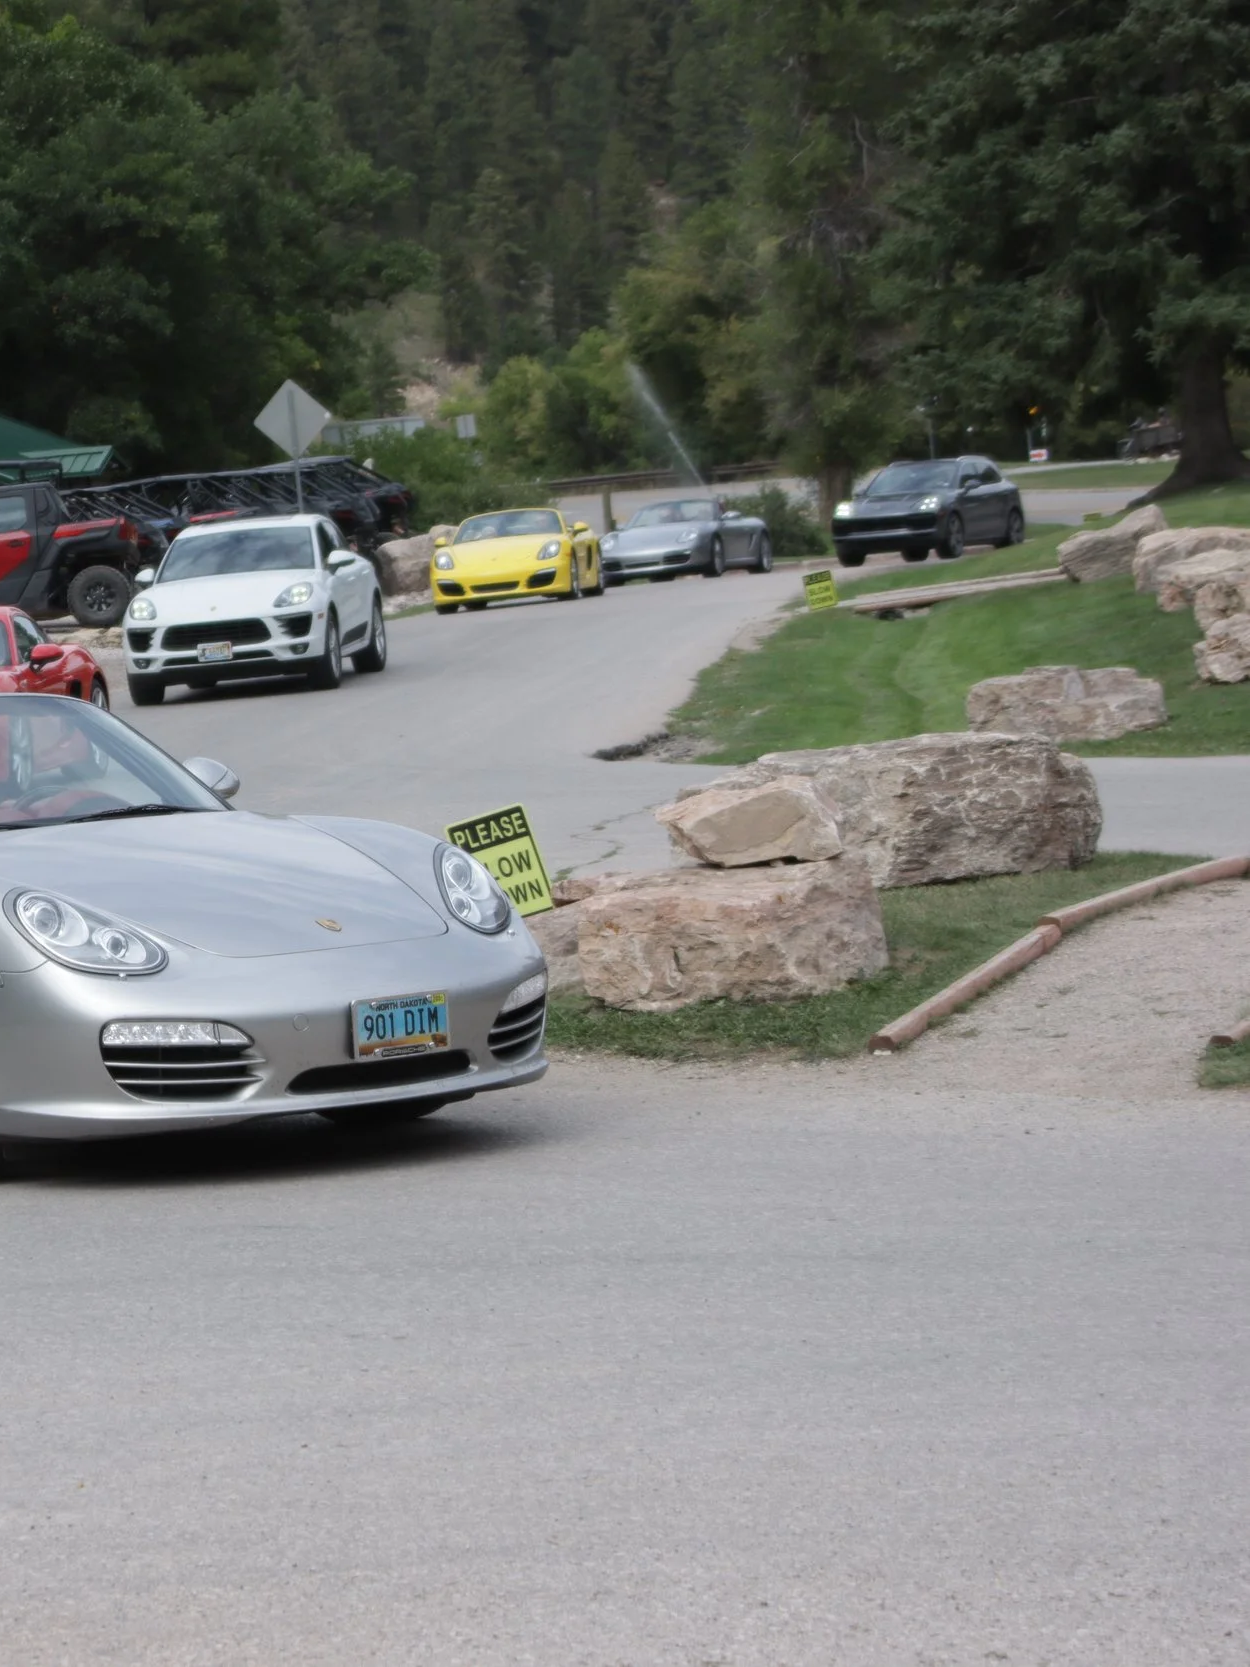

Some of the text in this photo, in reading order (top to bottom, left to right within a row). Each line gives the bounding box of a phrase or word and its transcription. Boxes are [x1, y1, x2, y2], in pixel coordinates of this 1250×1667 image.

[453, 812, 526, 849] PLEASE
[375, 1000, 398, 1011] NORTH
[399, 998, 428, 1009] DAKOTA
[363, 1006, 439, 1041] 901 DIM
